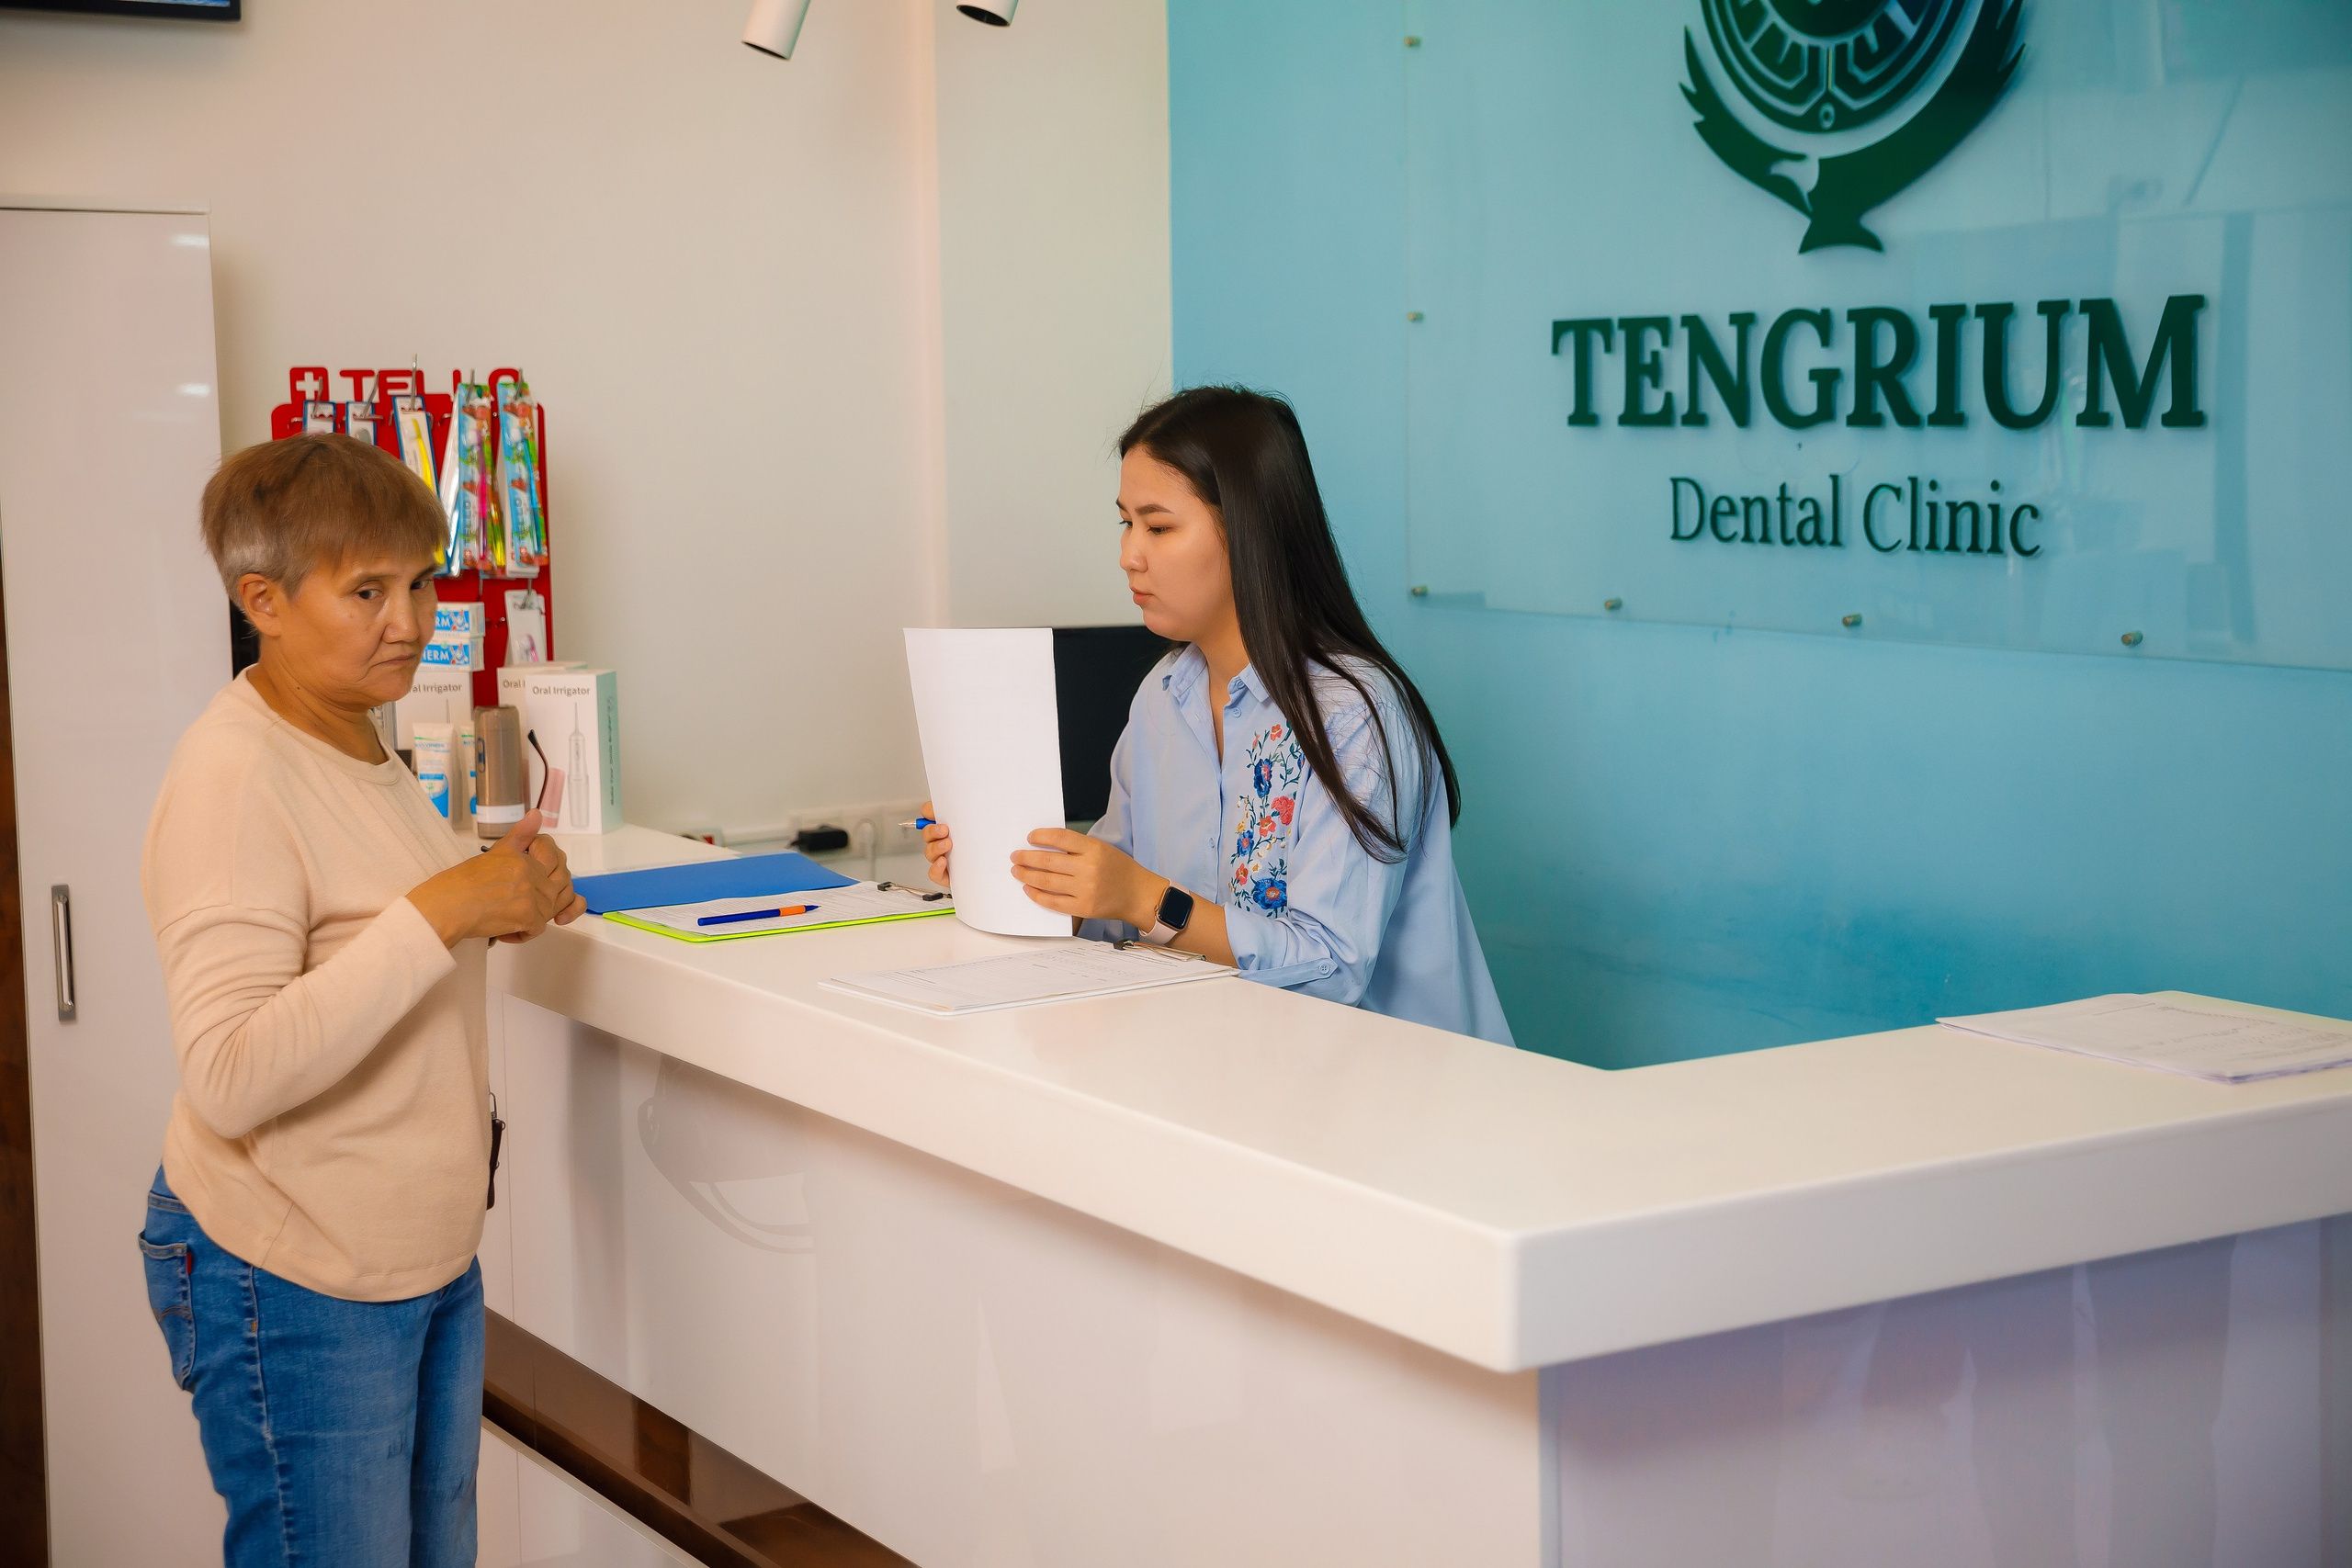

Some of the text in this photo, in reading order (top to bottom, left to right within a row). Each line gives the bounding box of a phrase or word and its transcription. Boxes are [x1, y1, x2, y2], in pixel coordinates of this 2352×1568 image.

[1552, 294, 2207, 429] TENGRIUM
[1669, 473, 2041, 557] Dental Clinic
[424, 682, 462, 694] Irrigator
[503, 680, 521, 688] Oral
[532, 685, 591, 697] Oral Irrigator
